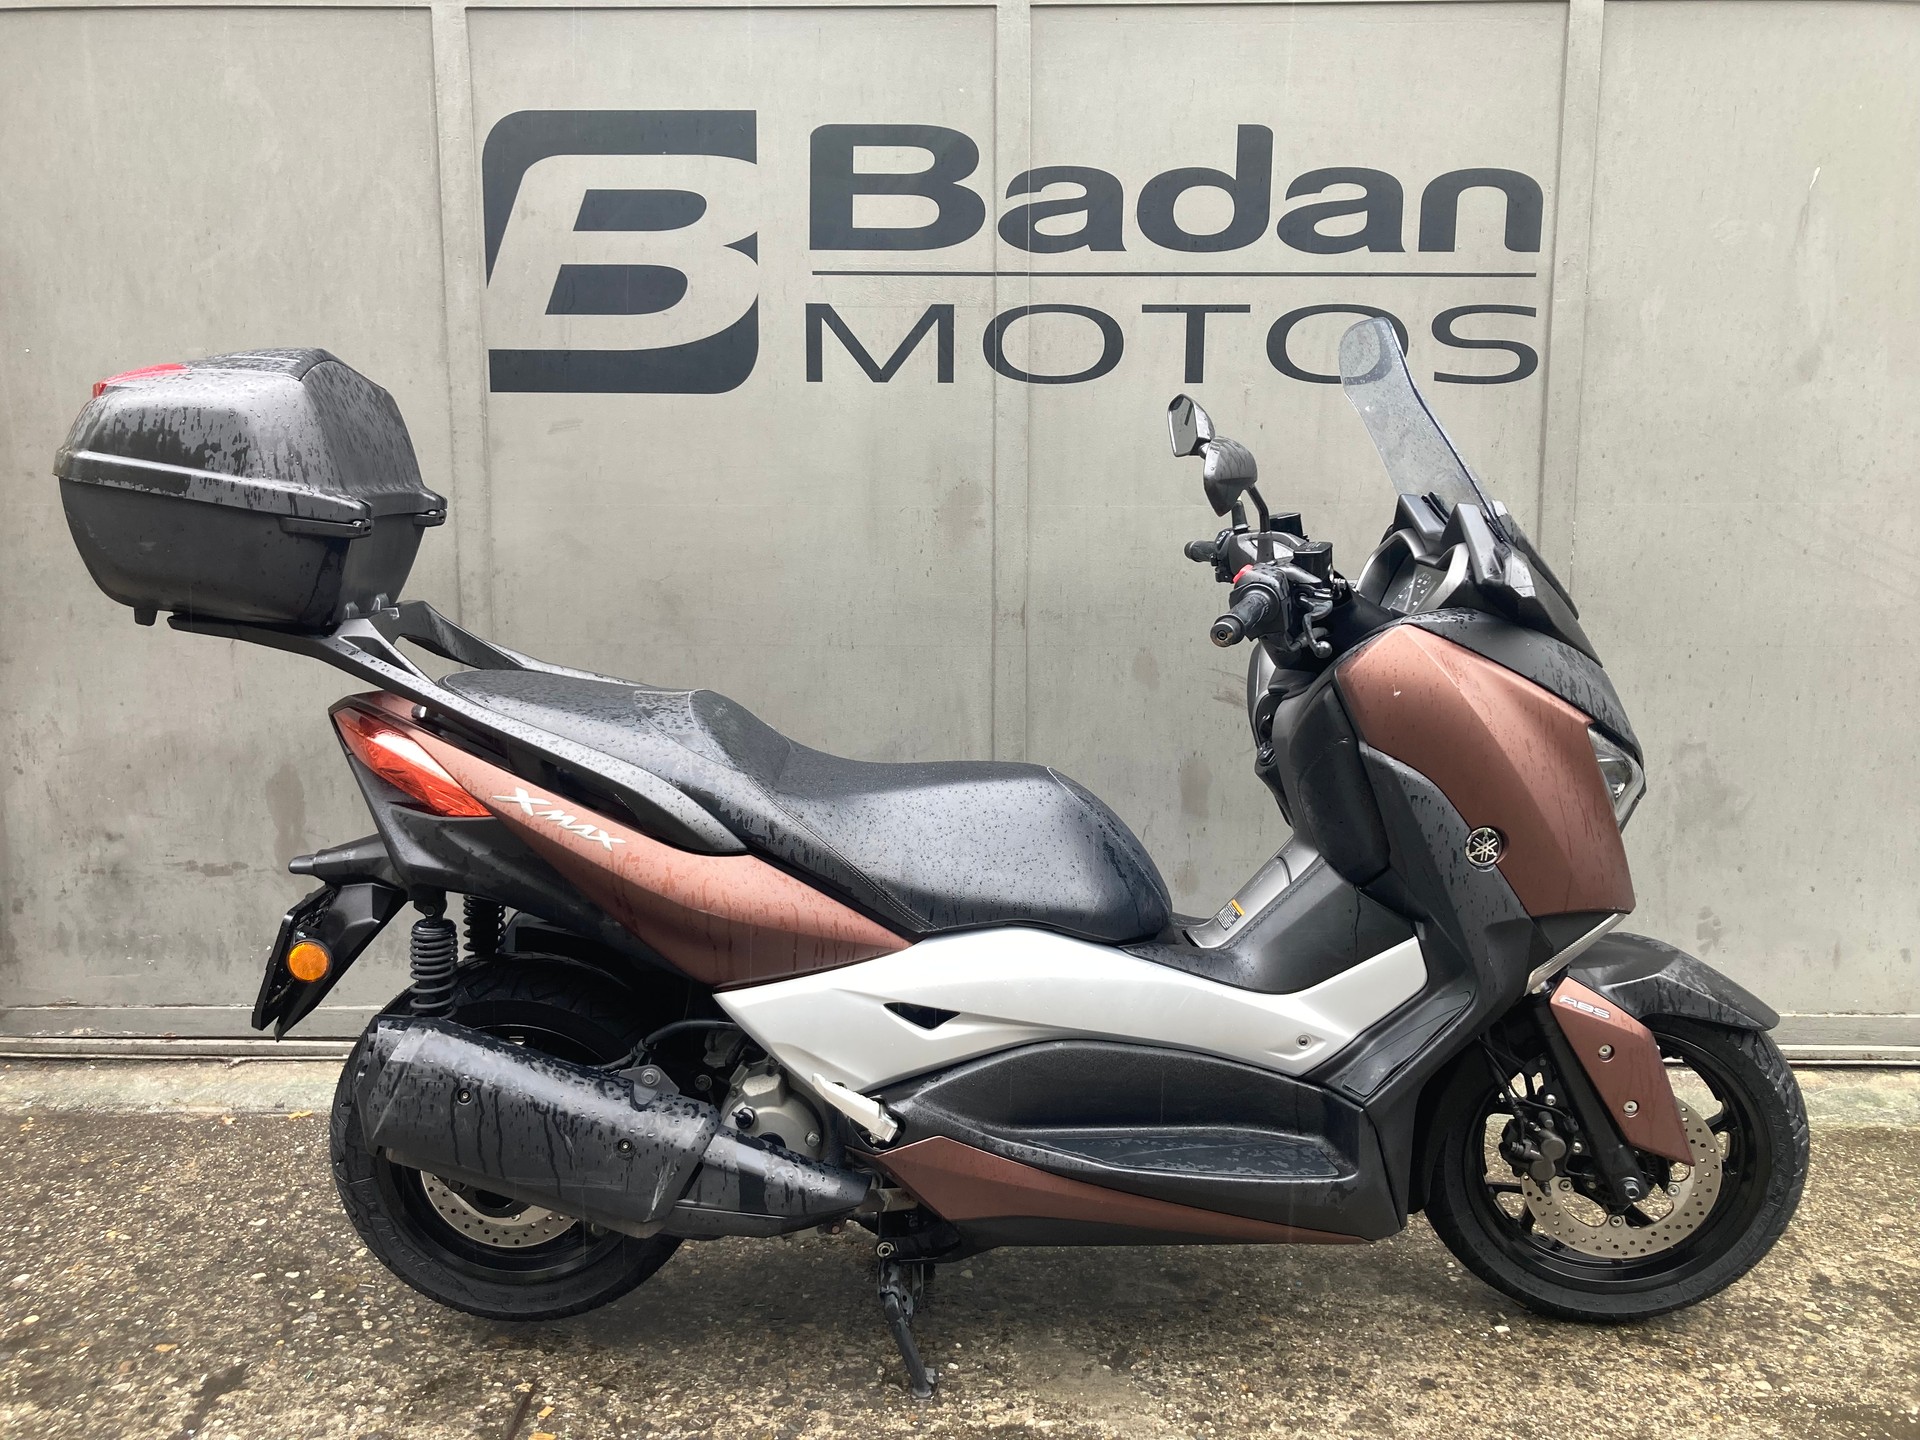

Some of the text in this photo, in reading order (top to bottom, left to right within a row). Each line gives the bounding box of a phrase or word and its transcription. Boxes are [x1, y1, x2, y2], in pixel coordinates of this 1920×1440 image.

[809, 124, 1544, 254] Badan
[805, 303, 1538, 384] MOTOS
[492, 788, 626, 851] XMAX
[1559, 995, 1610, 1018] ABS
